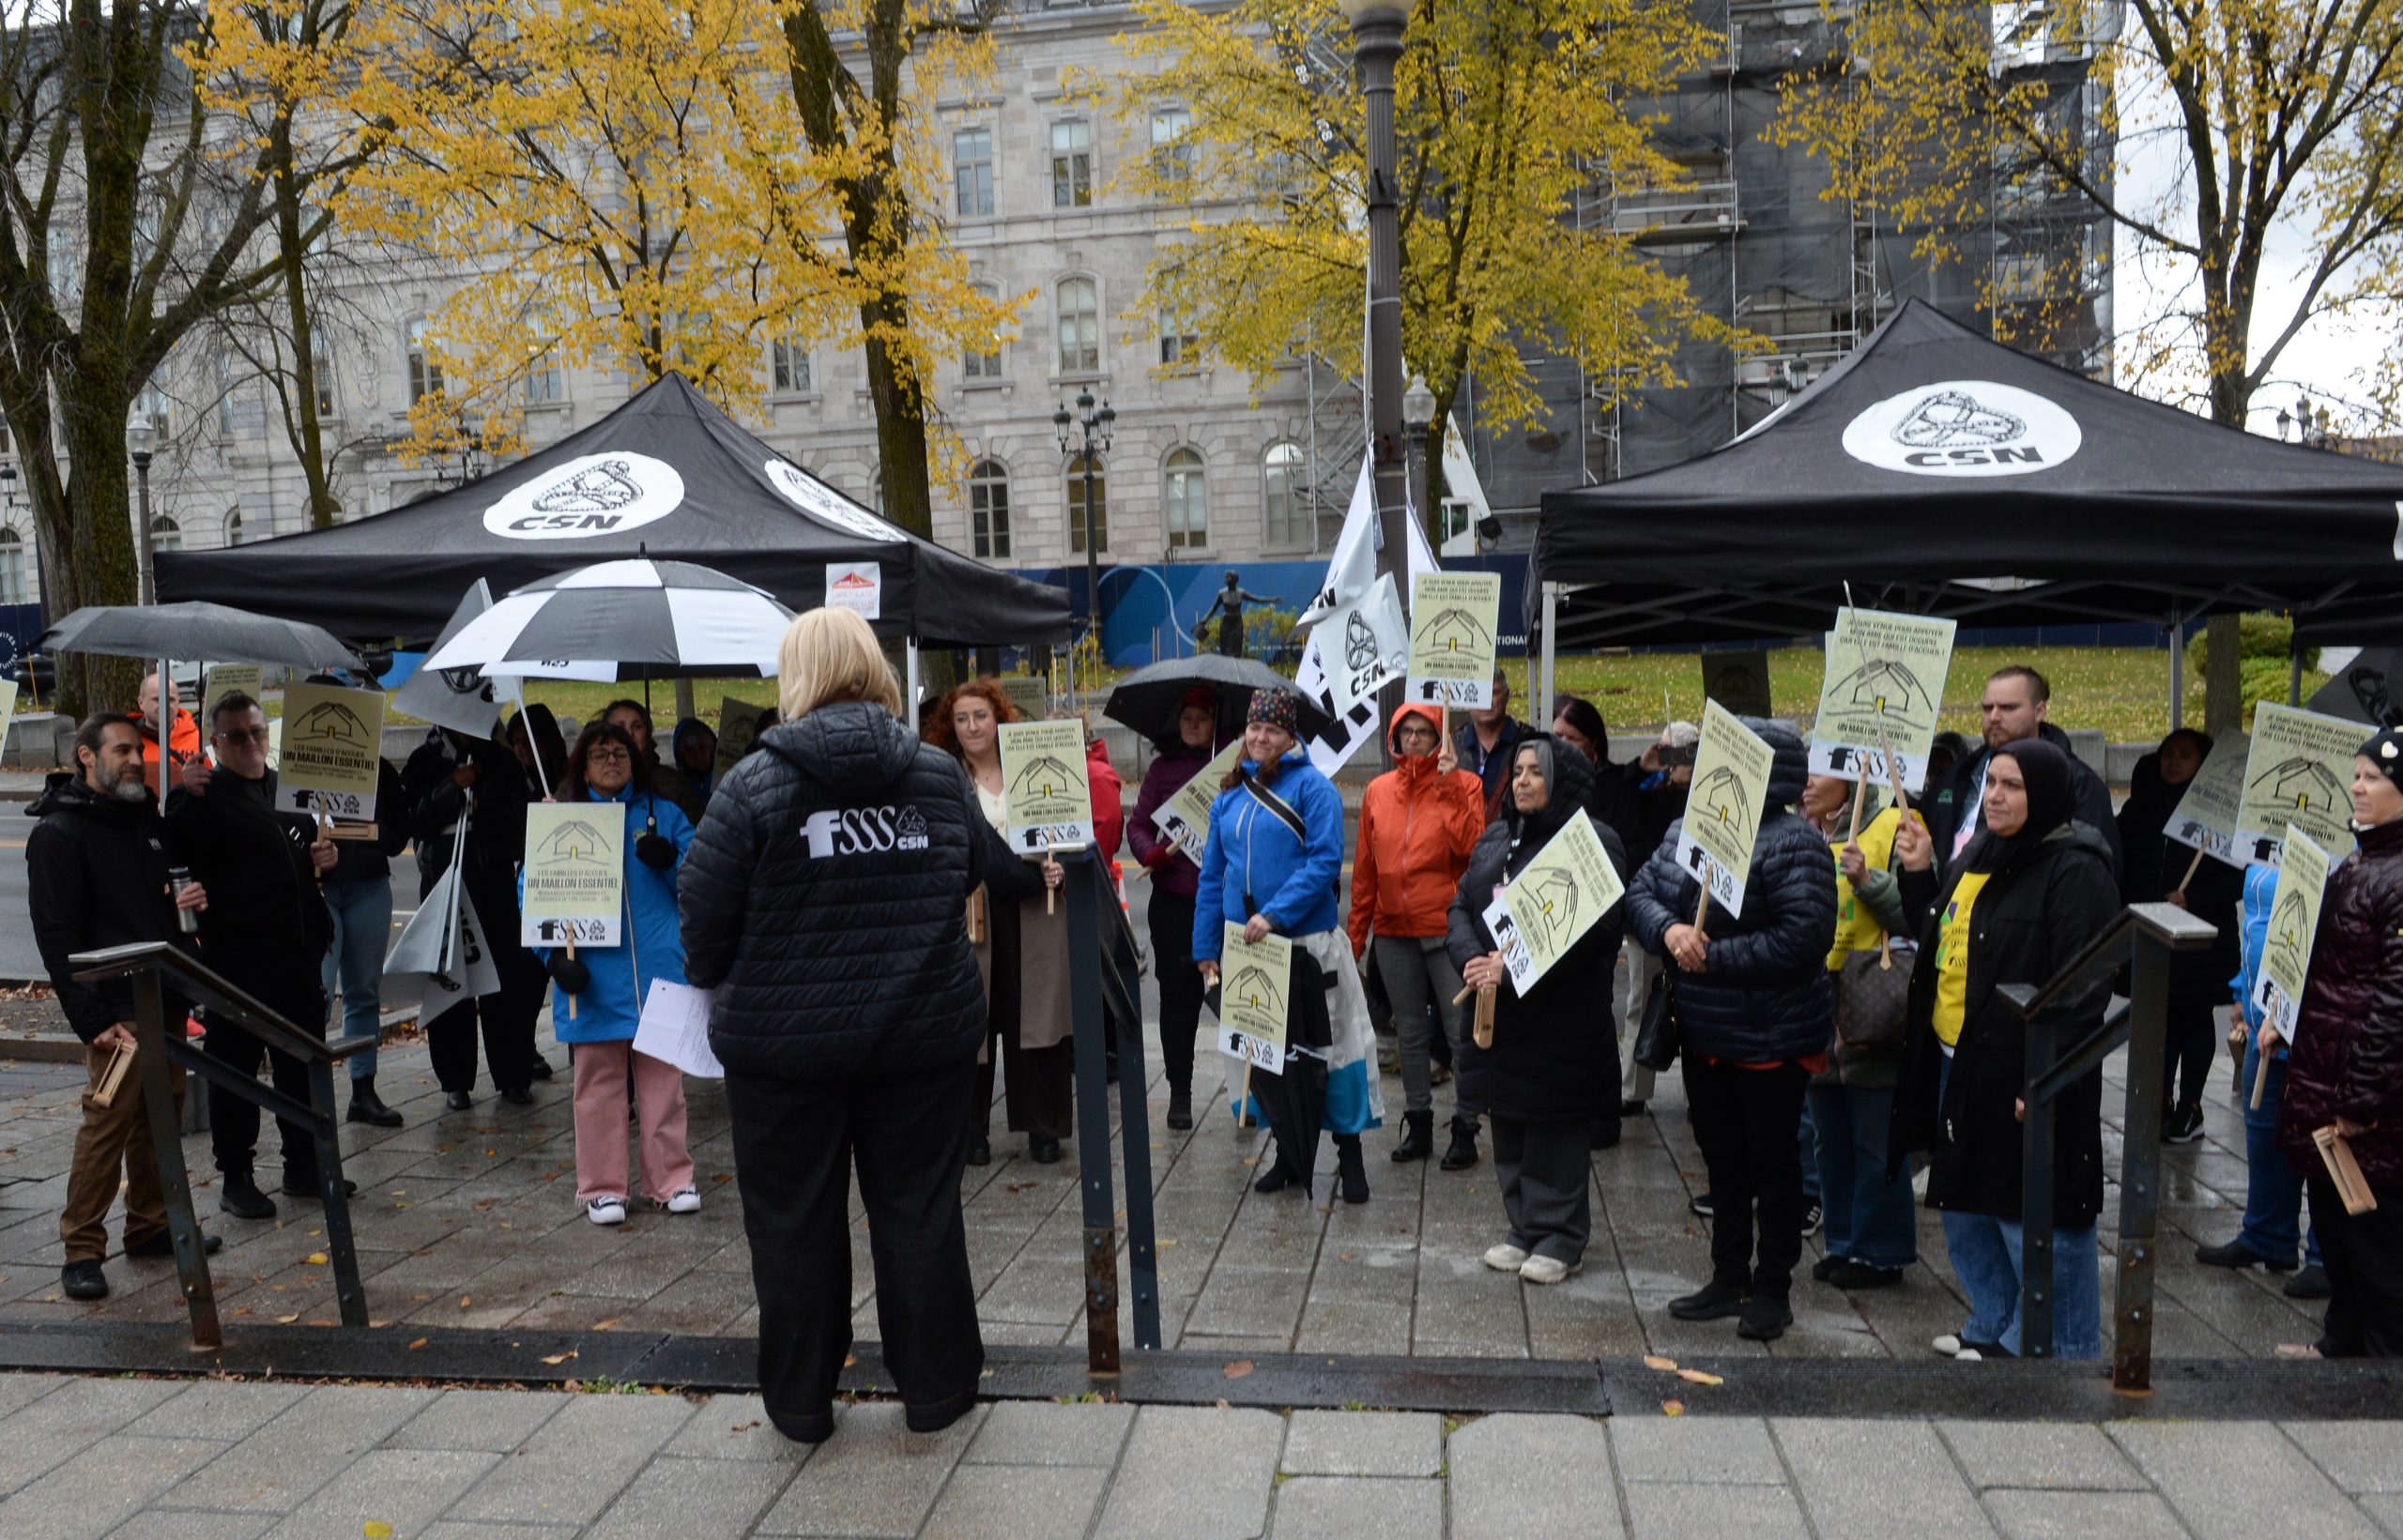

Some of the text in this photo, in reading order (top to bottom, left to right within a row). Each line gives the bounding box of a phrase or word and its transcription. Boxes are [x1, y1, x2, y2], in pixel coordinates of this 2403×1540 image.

[1905, 446, 2043, 465] CSN
[508, 514, 623, 530] CSN
[1350, 658, 1386, 696] CSN
[897, 834, 928, 850] CSN
